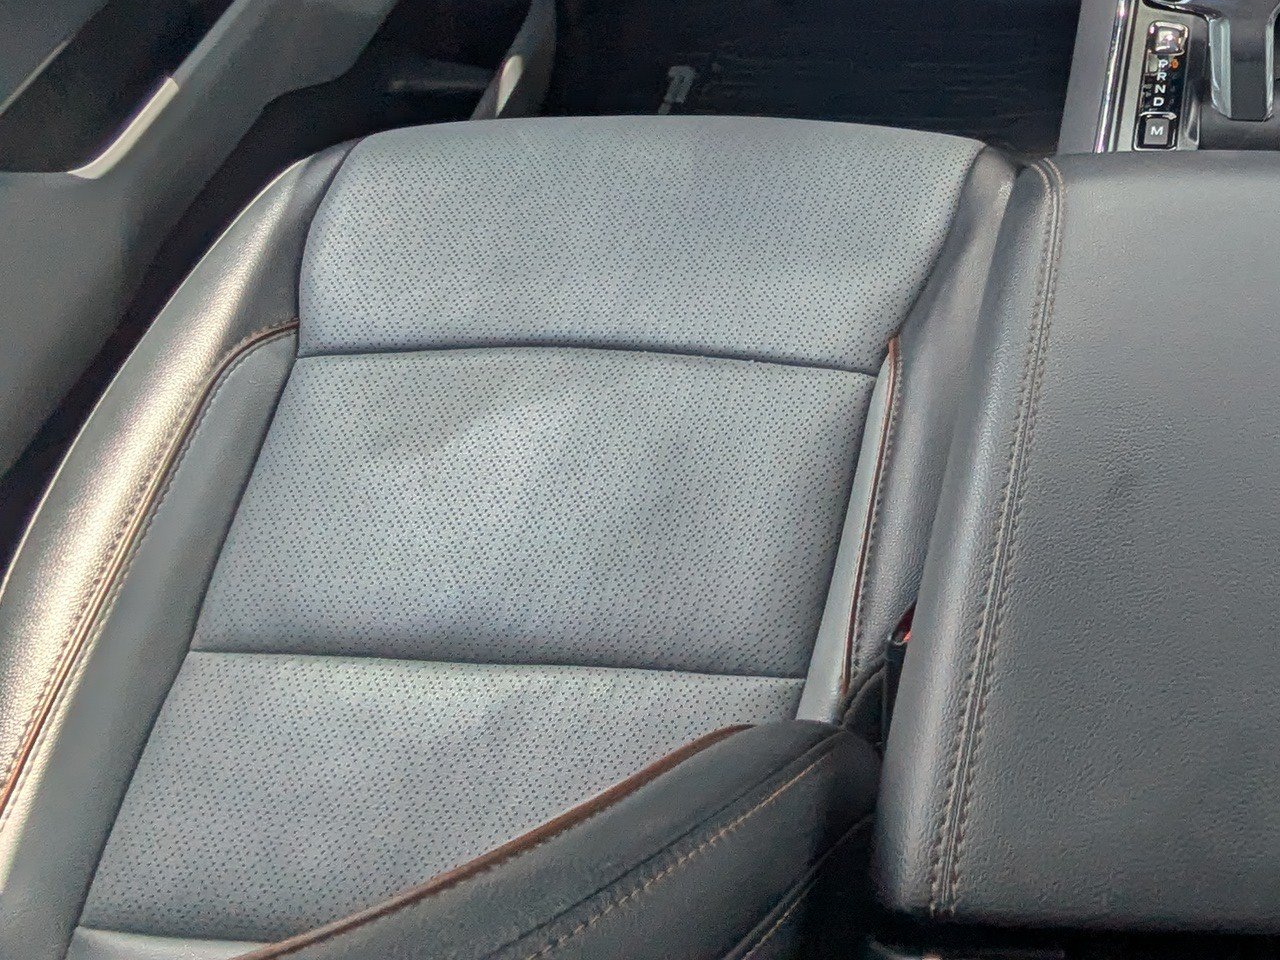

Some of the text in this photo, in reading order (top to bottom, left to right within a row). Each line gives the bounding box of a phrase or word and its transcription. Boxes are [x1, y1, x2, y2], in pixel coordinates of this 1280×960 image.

[1158, 59, 1169, 68] P
[1157, 72, 1166, 81] R
[1154, 85, 1166, 94] N
[1153, 97, 1165, 107] D
[1151, 126, 1164, 136] M
